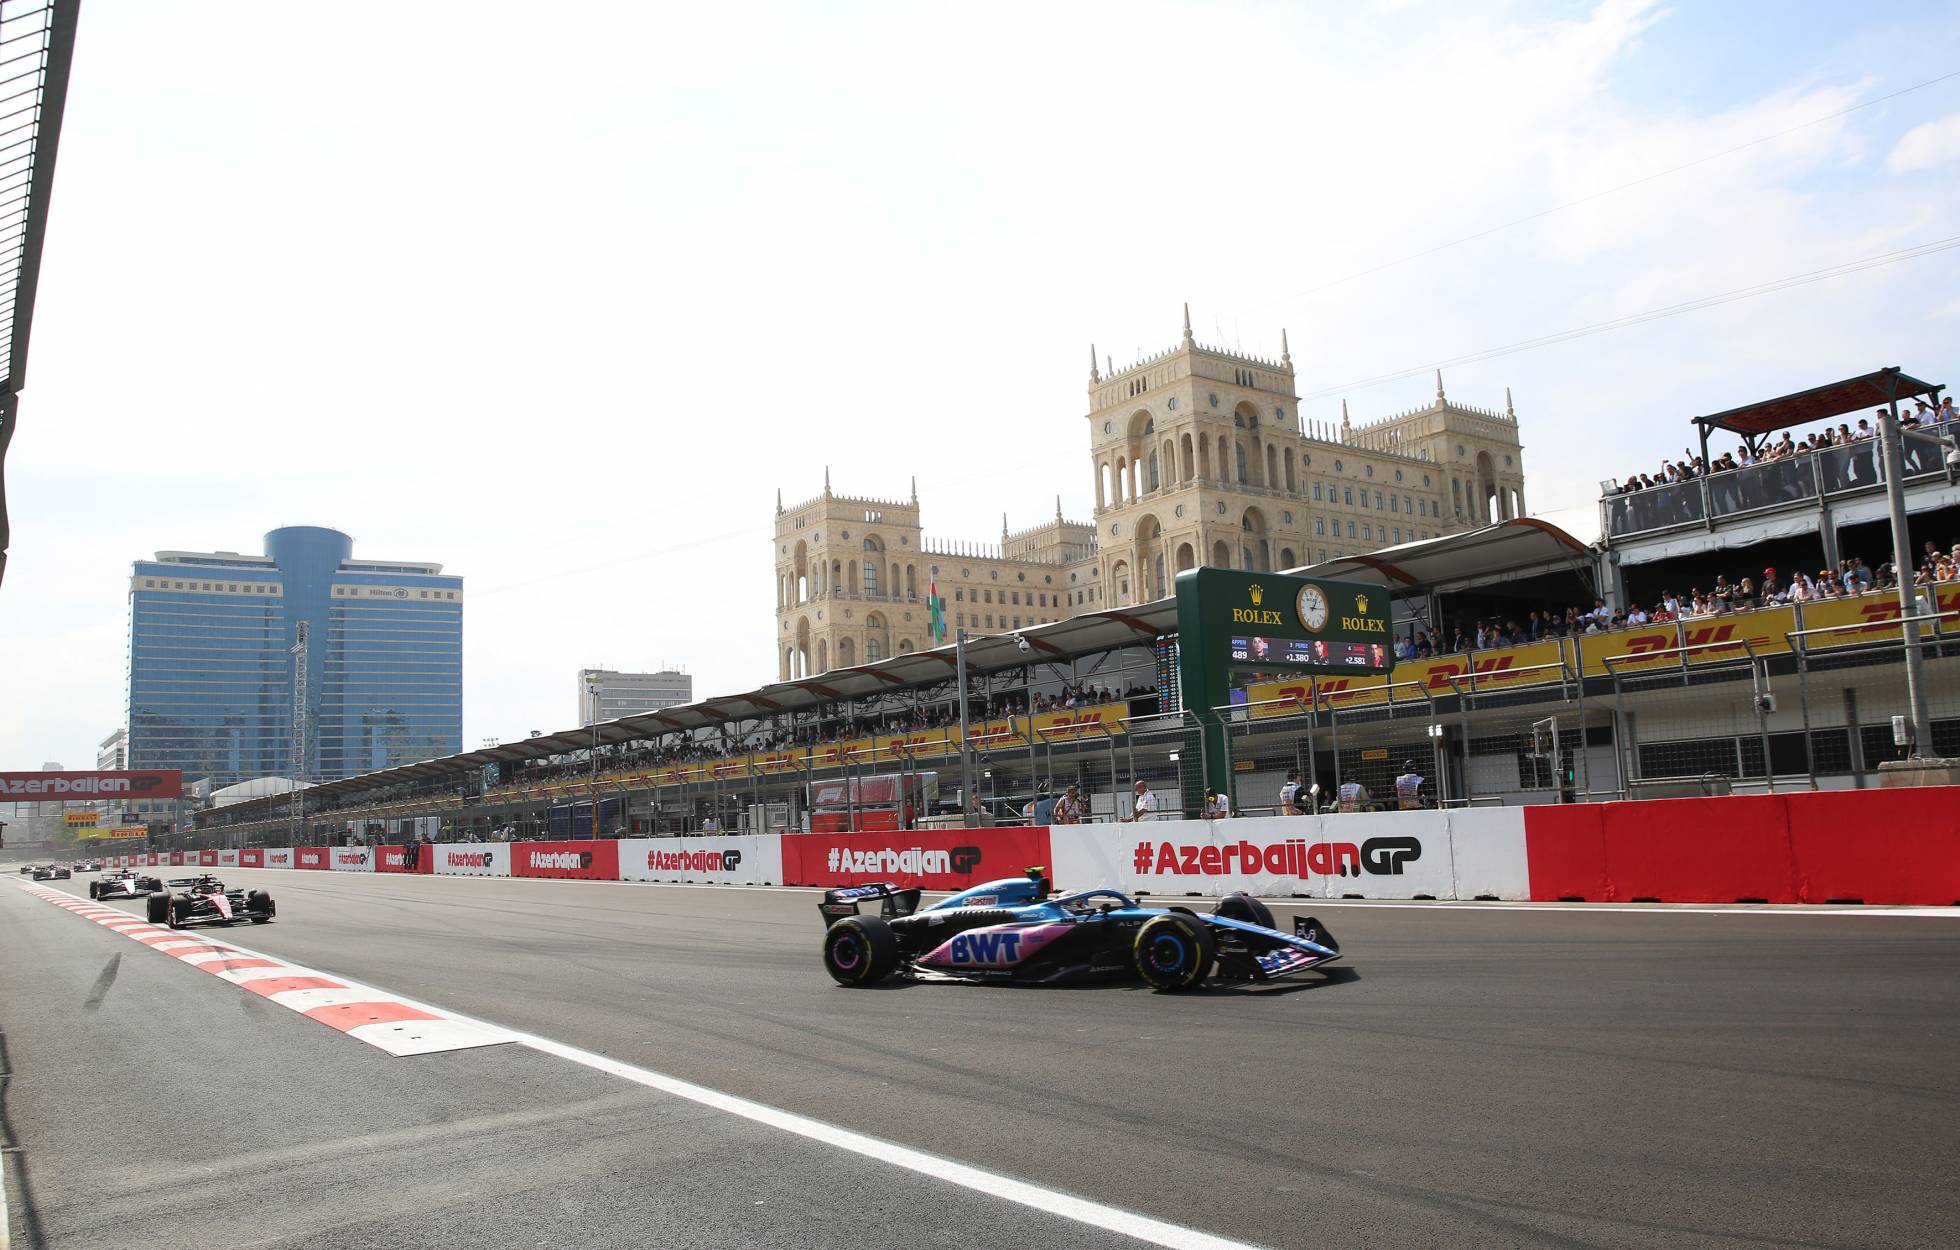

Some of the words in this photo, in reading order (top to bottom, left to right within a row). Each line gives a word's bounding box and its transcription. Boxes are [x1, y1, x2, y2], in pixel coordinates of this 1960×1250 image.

[1233, 609, 1282, 625] ROLEX
[1342, 617, 1386, 633] ROLEX
[1623, 624, 1742, 664] DHL
[1232, 651, 1247, 659] 489
[1428, 656, 1521, 689] DHL
[1278, 680, 1354, 708] DHL
[1050, 712, 1103, 735] DHL
[967, 726, 1012, 745] DHL
[825, 746, 859, 763] DHL
[889, 737, 929, 755] DHL
[765, 755, 794, 770] DHL
[448, 852, 493, 868] #AzerbaijanGP
[530, 851, 592, 870] #AzerbaijanGP
[648, 849, 741, 873] #AzerbaijanGP
[828, 846, 981, 876] #AzerbaijanGP
[1134, 836, 1421, 879] #AzerbaijanGP
[970, 896, 997, 906] Castrol
[951, 932, 1023, 966] BWT
